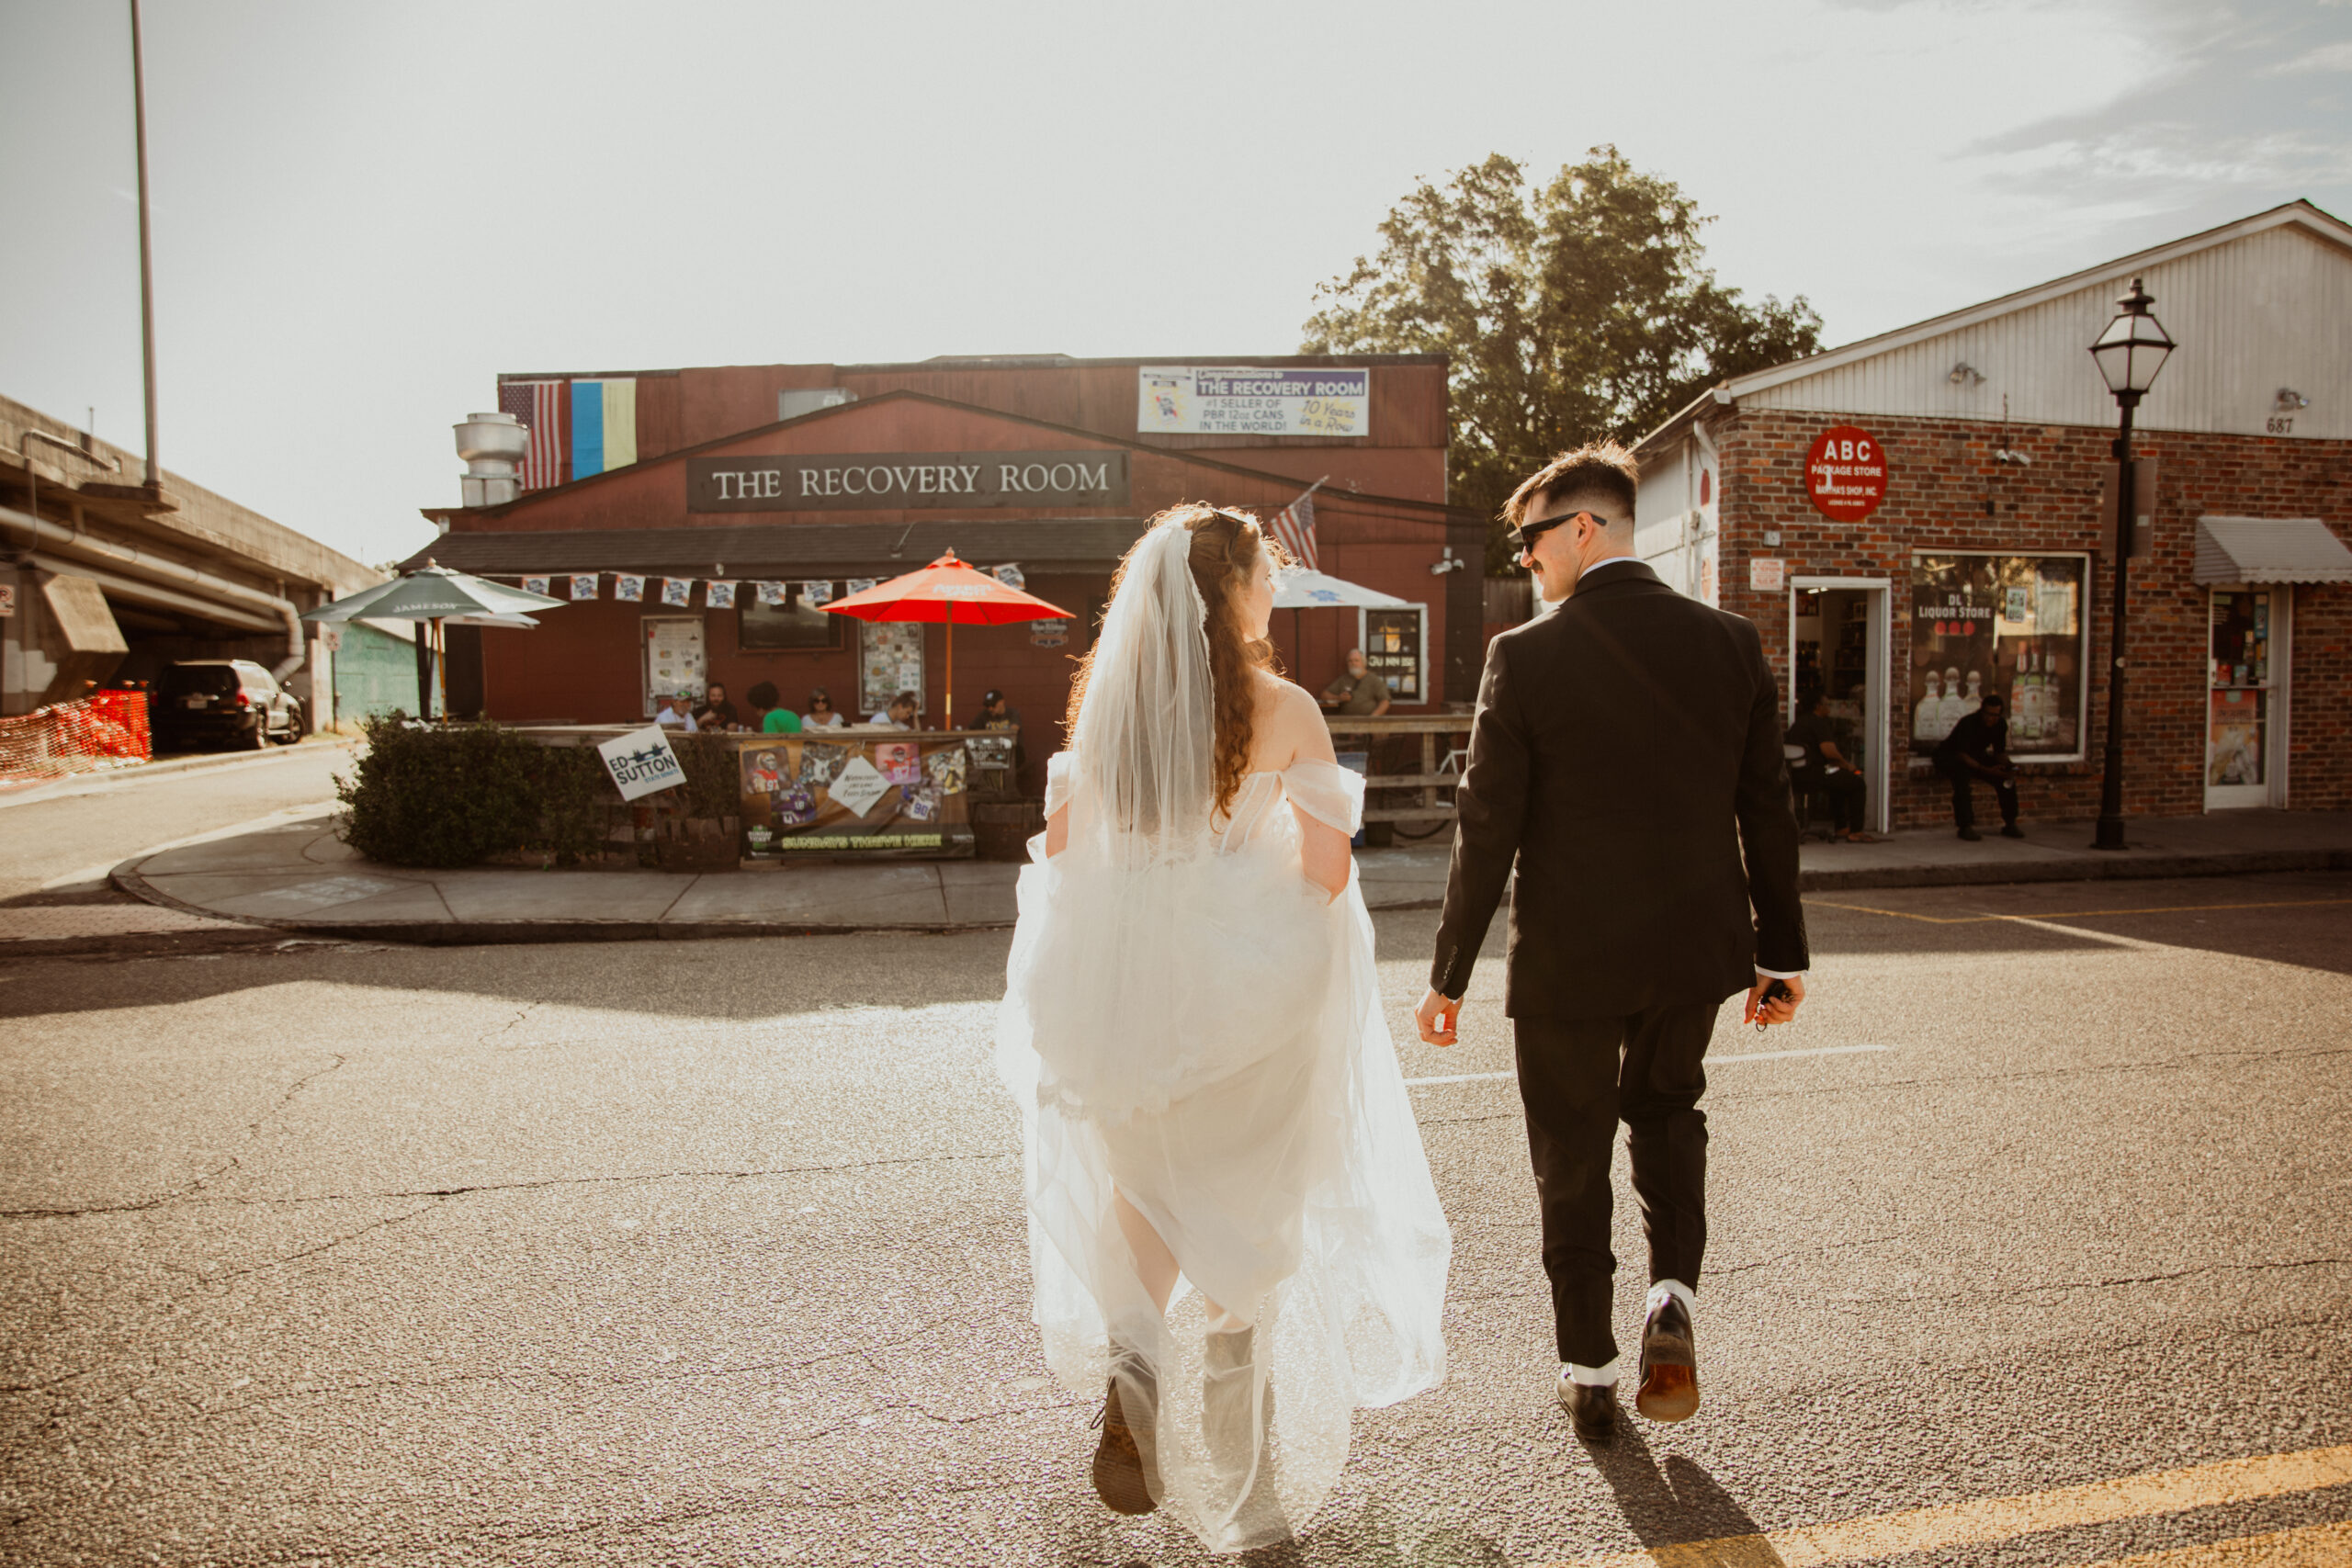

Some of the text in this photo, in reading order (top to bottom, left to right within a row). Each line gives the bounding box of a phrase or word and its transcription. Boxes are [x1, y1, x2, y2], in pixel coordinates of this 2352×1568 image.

[1199, 381, 1363, 396] THE RECOVERY ROOM
[1206, 399, 1282, 409] #1 SELLER OF
[1302, 400, 1355, 419] 10 Years
[1204, 410, 1226, 419] PBR
[1253, 410, 1284, 420] CANS
[1199, 421, 1286, 431] IN THE WORLD!
[1299, 415, 1311, 425] in
[1325, 417, 1352, 432] Row
[2266, 417, 2293, 434] 687
[1824, 439, 1871, 462] ABC
[1811, 464, 1883, 477] PACKAGE STORE
[713, 463, 1110, 499] THE RECOVERY ROOM
[1949, 594, 1962, 605] DL
[392, 602, 458, 614] JAMESON
[1918, 606, 1991, 619] LIQUOR STORE
[1368, 654, 1416, 667] GUNNESS
[608, 756, 628, 772] ED
[616, 754, 677, 784] SUTTON
[913, 802, 928, 817] 90
[782, 836, 849, 850] SUNDAYS
[850, 835, 902, 849] THRIVE
[903, 834, 942, 847] HERE
